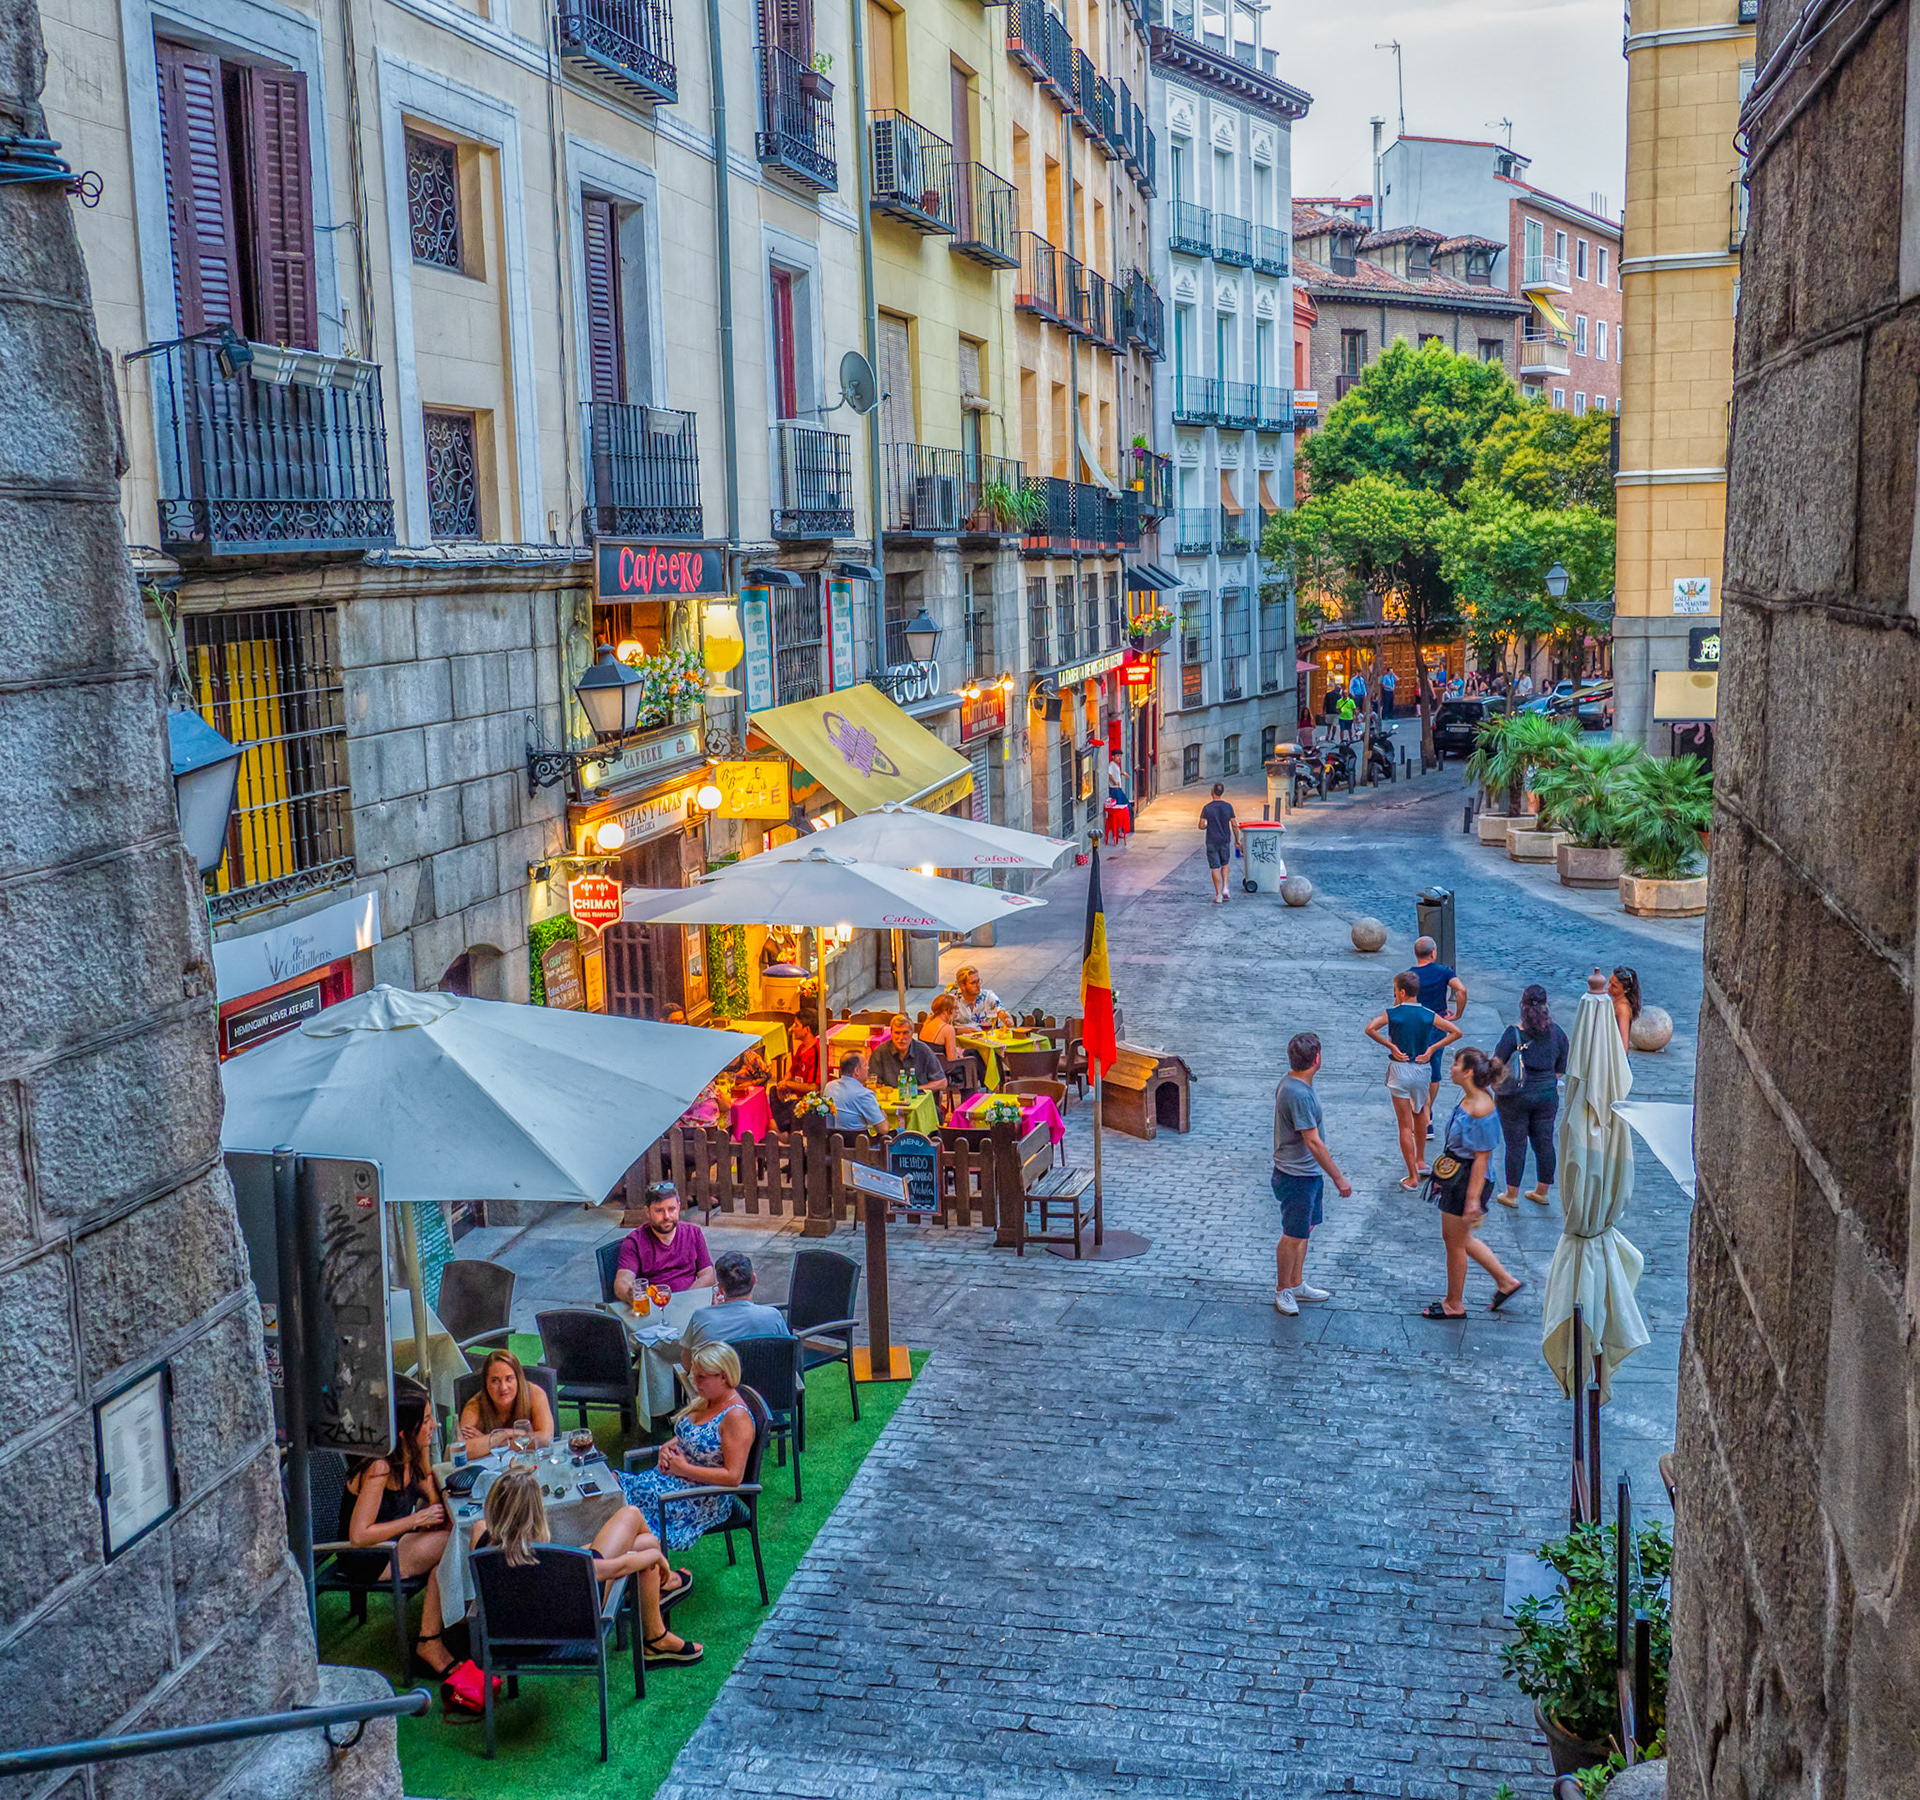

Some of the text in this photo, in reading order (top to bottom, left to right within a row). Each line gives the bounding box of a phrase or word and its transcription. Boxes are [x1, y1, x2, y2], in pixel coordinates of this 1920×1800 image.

[624, 745, 664, 770] CAFEEKE
[648, 802, 655, 820] Y
[657, 791, 683, 816] TAPAS
[574, 898, 619, 910] CHIMAY
[284, 948, 333, 977] Cuchilleros
[234, 998, 315, 1037] HEMINGWAY NEVER ATE HERE
[900, 1137, 924, 1147] MENU
